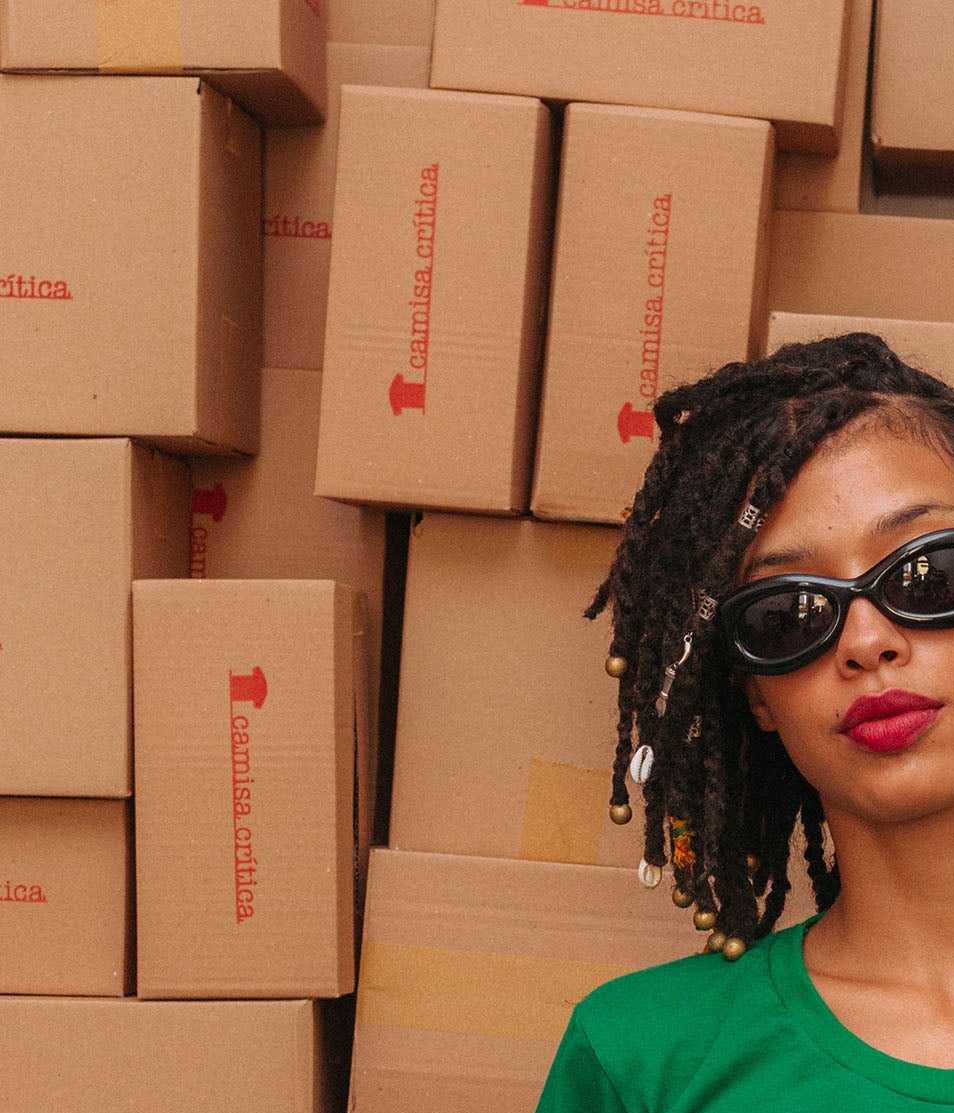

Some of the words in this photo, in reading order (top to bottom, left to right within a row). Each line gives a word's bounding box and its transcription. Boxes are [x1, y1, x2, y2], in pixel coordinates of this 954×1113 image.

[413, 163, 439, 258] crítica
[645, 194, 672, 289] crítica
[408, 262, 434, 372] camisa
[639, 294, 664, 400] camisa
[230, 712, 254, 820] camisa
[233, 824, 258, 924] crítica
